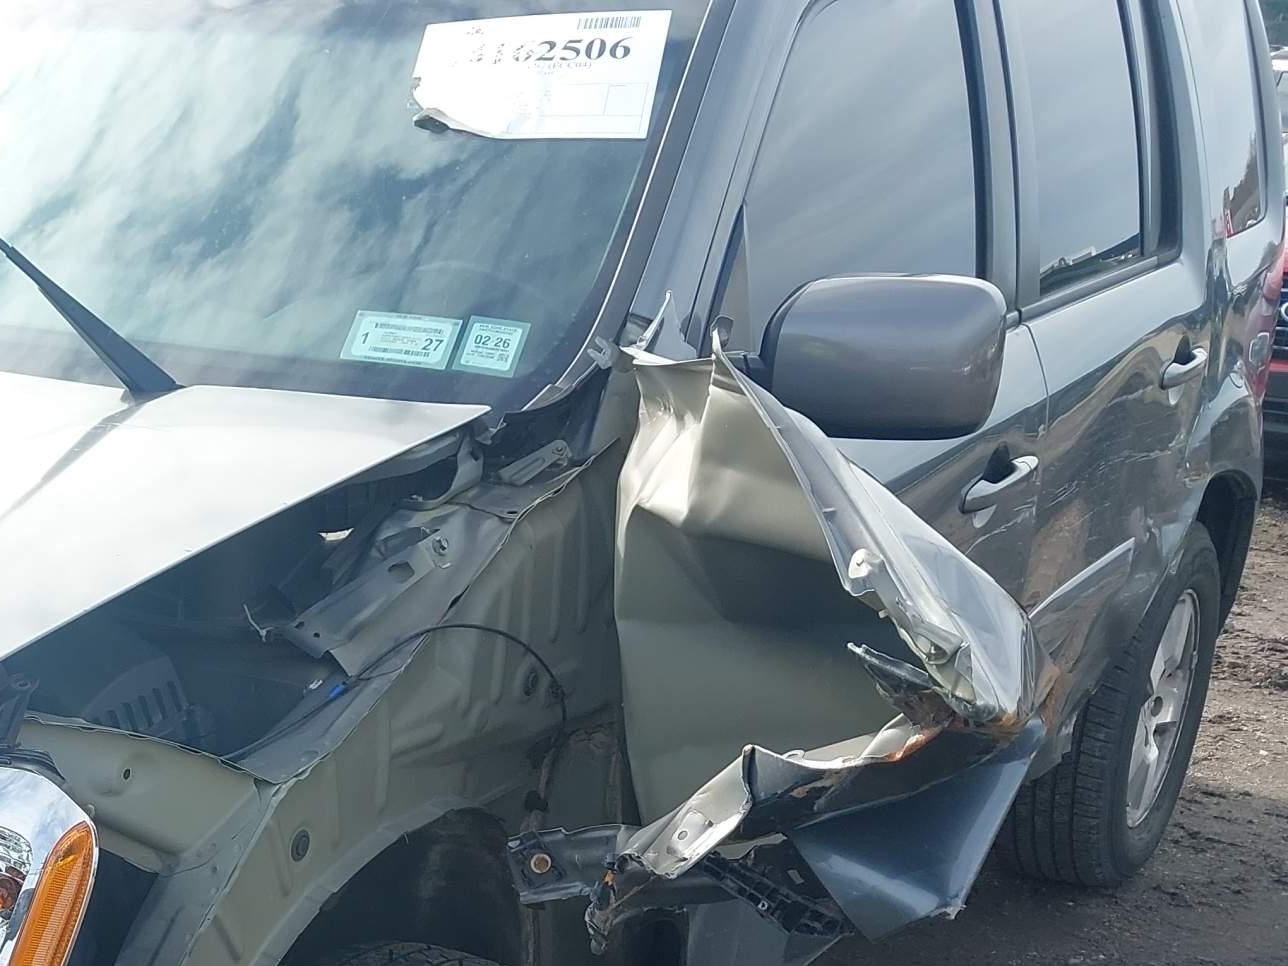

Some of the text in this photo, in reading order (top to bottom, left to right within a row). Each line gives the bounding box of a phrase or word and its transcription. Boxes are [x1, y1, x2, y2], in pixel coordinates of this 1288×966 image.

[361, 331, 370, 345] 1
[420, 338, 445, 352] 27
[473, 334, 512, 349] 02 26
